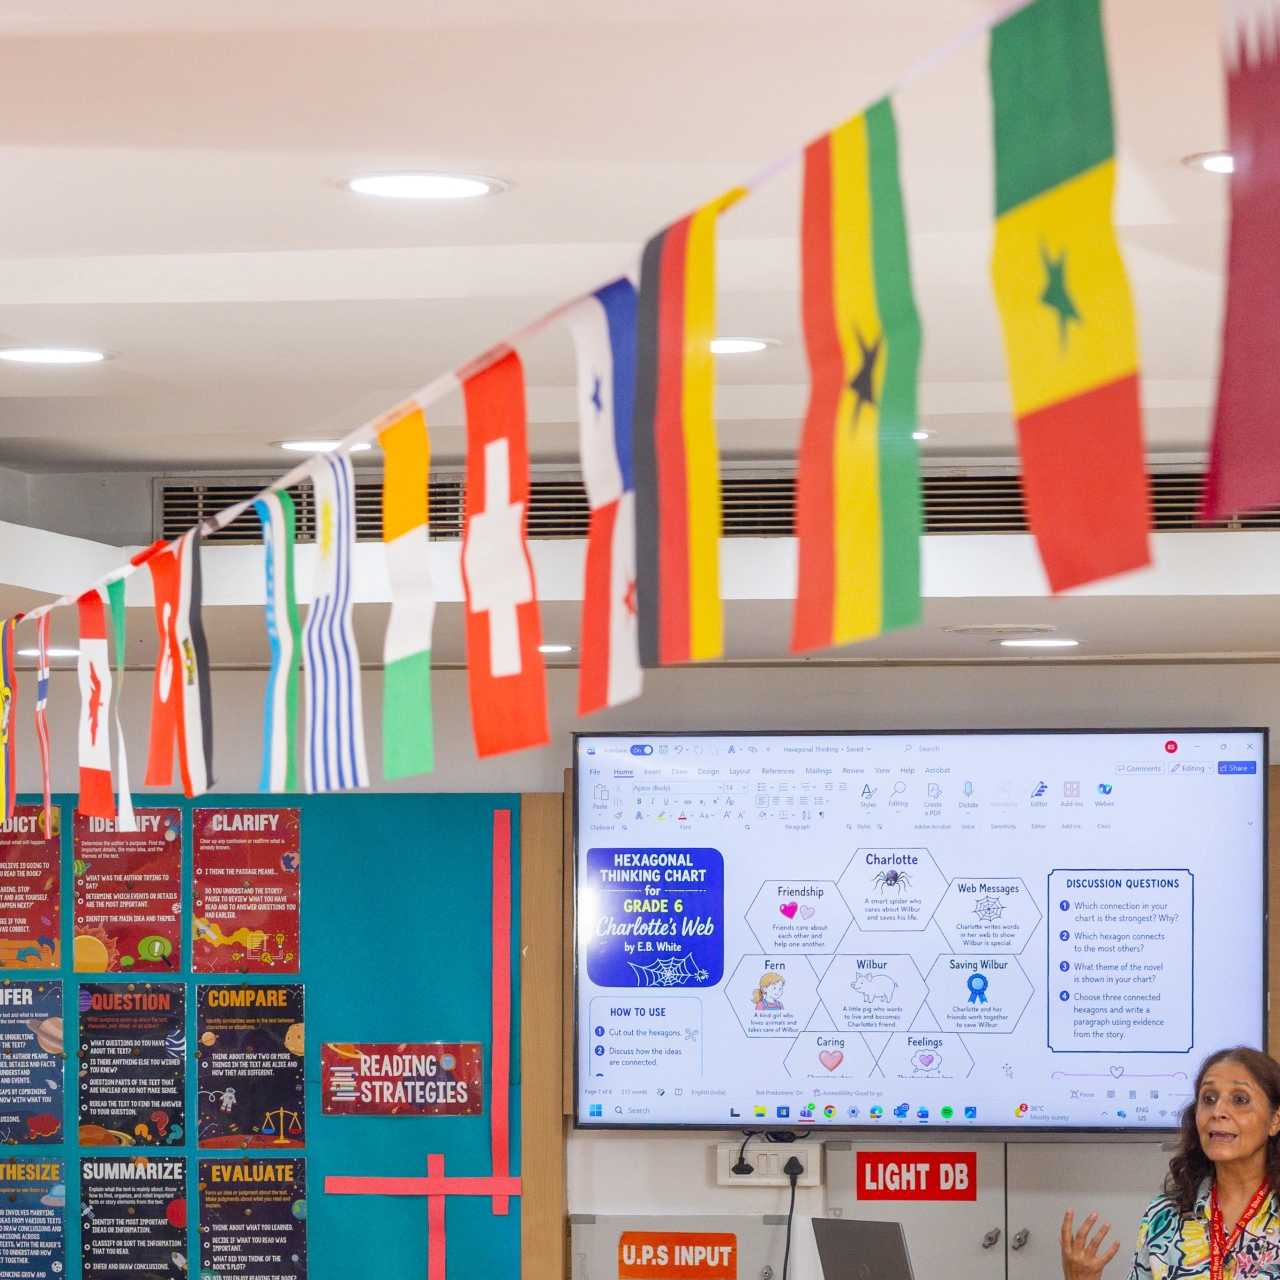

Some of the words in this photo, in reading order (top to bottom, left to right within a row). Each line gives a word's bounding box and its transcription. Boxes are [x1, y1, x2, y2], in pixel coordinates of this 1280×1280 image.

[90, 816, 160, 832] IDEIFY
[213, 814, 279, 831] CLARIFY
[614, 854, 693, 866] HEXAGONAL
[866, 853, 918, 866] Charlotte
[600, 870, 661, 881] THINKING
[665, 870, 706, 881] CHART
[958, 884, 977, 894] Web
[979, 884, 1019, 896] Messages
[1067, 879, 1122, 888] DISCUSSION
[1126, 879, 1179, 889] QUESTIONS
[645, 885, 661, 896] for
[778, 886, 824, 898] Friendship
[624, 900, 668, 912] GRADE
[674, 900, 683, 912] 6
[1074, 902, 1098, 910] Which
[1100, 902, 1140, 910] connection
[1142, 902, 1149, 910] in
[1151, 903, 1167, 912] your
[1075, 914, 1094, 922] chart
[1098, 914, 1102, 922] is
[1105, 914, 1116, 922] the
[1119, 914, 1156, 924] strongest?
[1159, 914, 1178, 924] Why?
[596, 916, 676, 936] Charlotte's
[682, 917, 714, 936] Web
[624, 942, 635, 954] by
[638, 942, 654, 951] E.B.
[657, 942, 682, 951] White
[765, 960, 785, 970] Fern
[856, 960, 887, 970] Wilbur
[950, 960, 977, 972] Saving
[980, 960, 1008, 970] Wilbur
[92, 994, 170, 1010] QUESTION
[208, 990, 287, 1007] COMPARE
[610, 1008, 631, 1016] HOW
[635, 1008, 645, 1016] TO
[649, 1008, 666, 1016] USE
[817, 1037, 845, 1048] Caring
[908, 1037, 943, 1048] Feelings
[361, 1055, 436, 1076] READING
[361, 1082, 467, 1103] STRATEGIES
[83, 1163, 182, 1180] SUMMARIZE
[212, 1165, 293, 1182] EVALUATE
[865, 1163, 929, 1190] LIGHT
[939, 1163, 970, 1188] DB
[623, 1244, 668, 1266] U.P.S
[675, 1246, 732, 1267] INPUT
